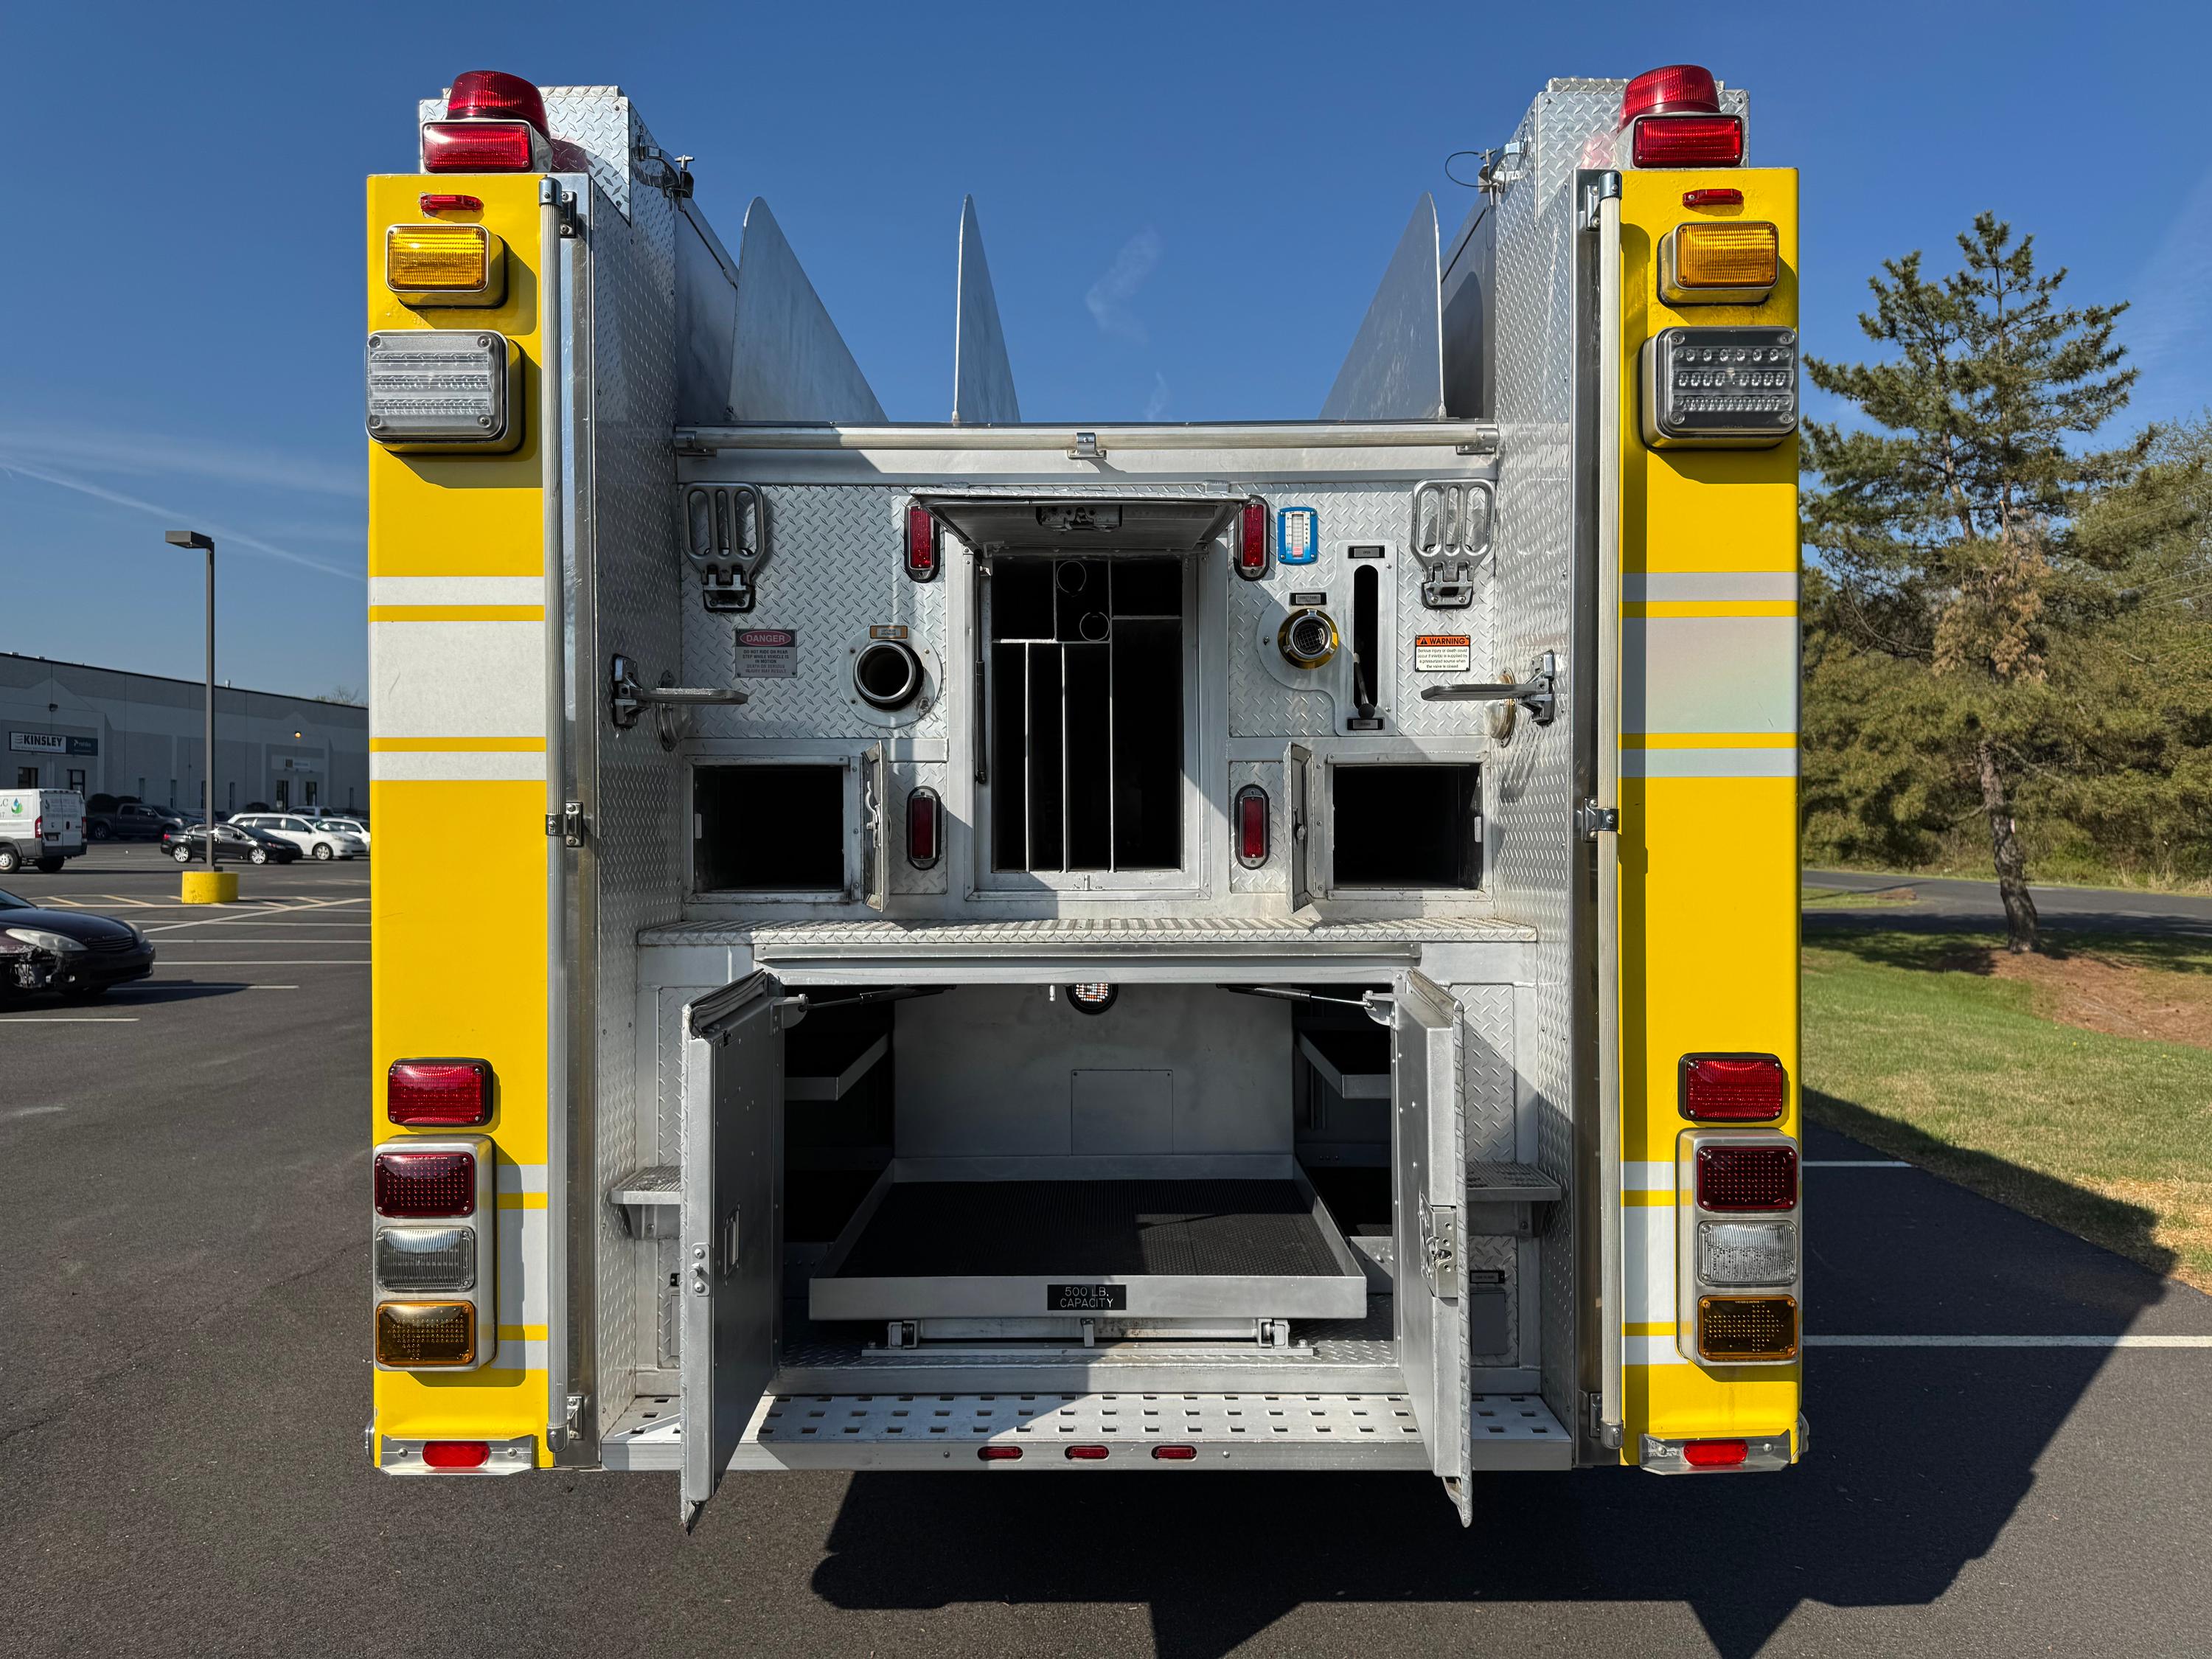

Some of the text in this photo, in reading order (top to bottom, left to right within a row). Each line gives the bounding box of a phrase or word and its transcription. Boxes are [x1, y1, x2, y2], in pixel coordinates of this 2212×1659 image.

[24, 734, 62, 747] KINSLEY
[1065, 1287, 1109, 1296] 500 LB.
[1060, 1298, 1113, 1308] CAPACITY
